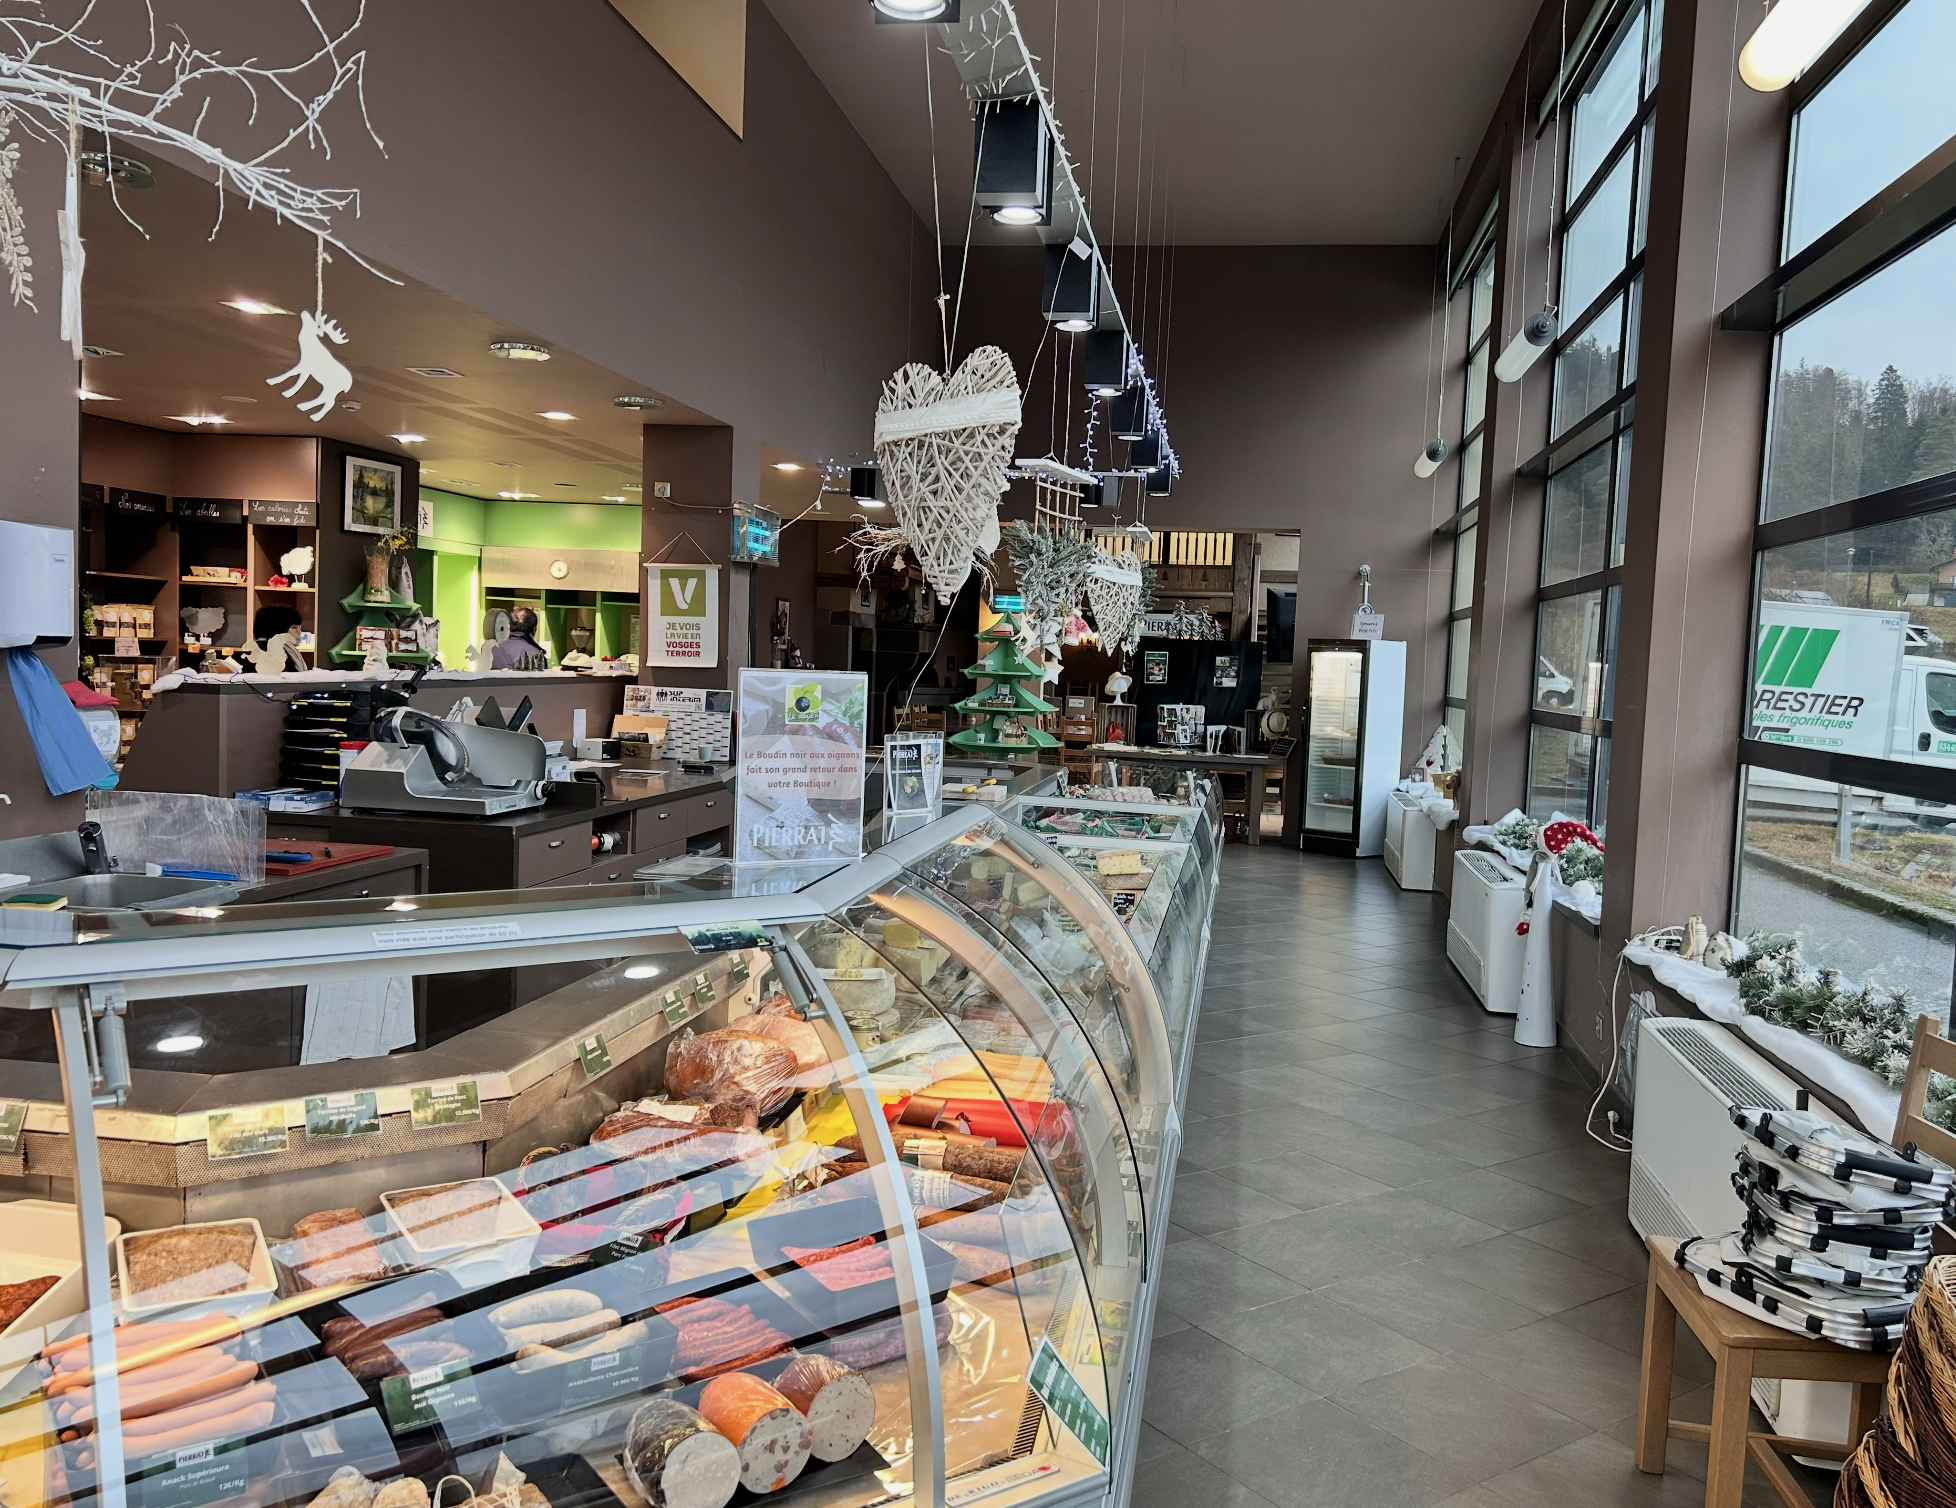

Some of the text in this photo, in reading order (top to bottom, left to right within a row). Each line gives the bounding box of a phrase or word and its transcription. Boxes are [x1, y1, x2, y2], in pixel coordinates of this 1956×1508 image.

[668, 577, 698, 609] V
[666, 622, 701, 631] JE VOIS
[666, 641, 701, 649] VOSGES
[1777, 713, 1853, 729] frigorifiques
[828, 751, 860, 760] oignons
[746, 766, 762, 775] fait
[782, 766, 807, 775] grand
[793, 780, 831, 789] Boutique
[753, 824, 825, 847] PIERRAT
[445, 932, 486, 940] participation
[568, 1366, 639, 1387] Andouillette Charcutière
[411, 1384, 451, 1401] Boudin Noir
[414, 1392, 455, 1410] aux Oignons
[178, 1451, 204, 1463] PIERRAT
[161, 1464, 229, 1486] Knack Supérieure
[219, 1479, 245, 1491] 12€/Kg
